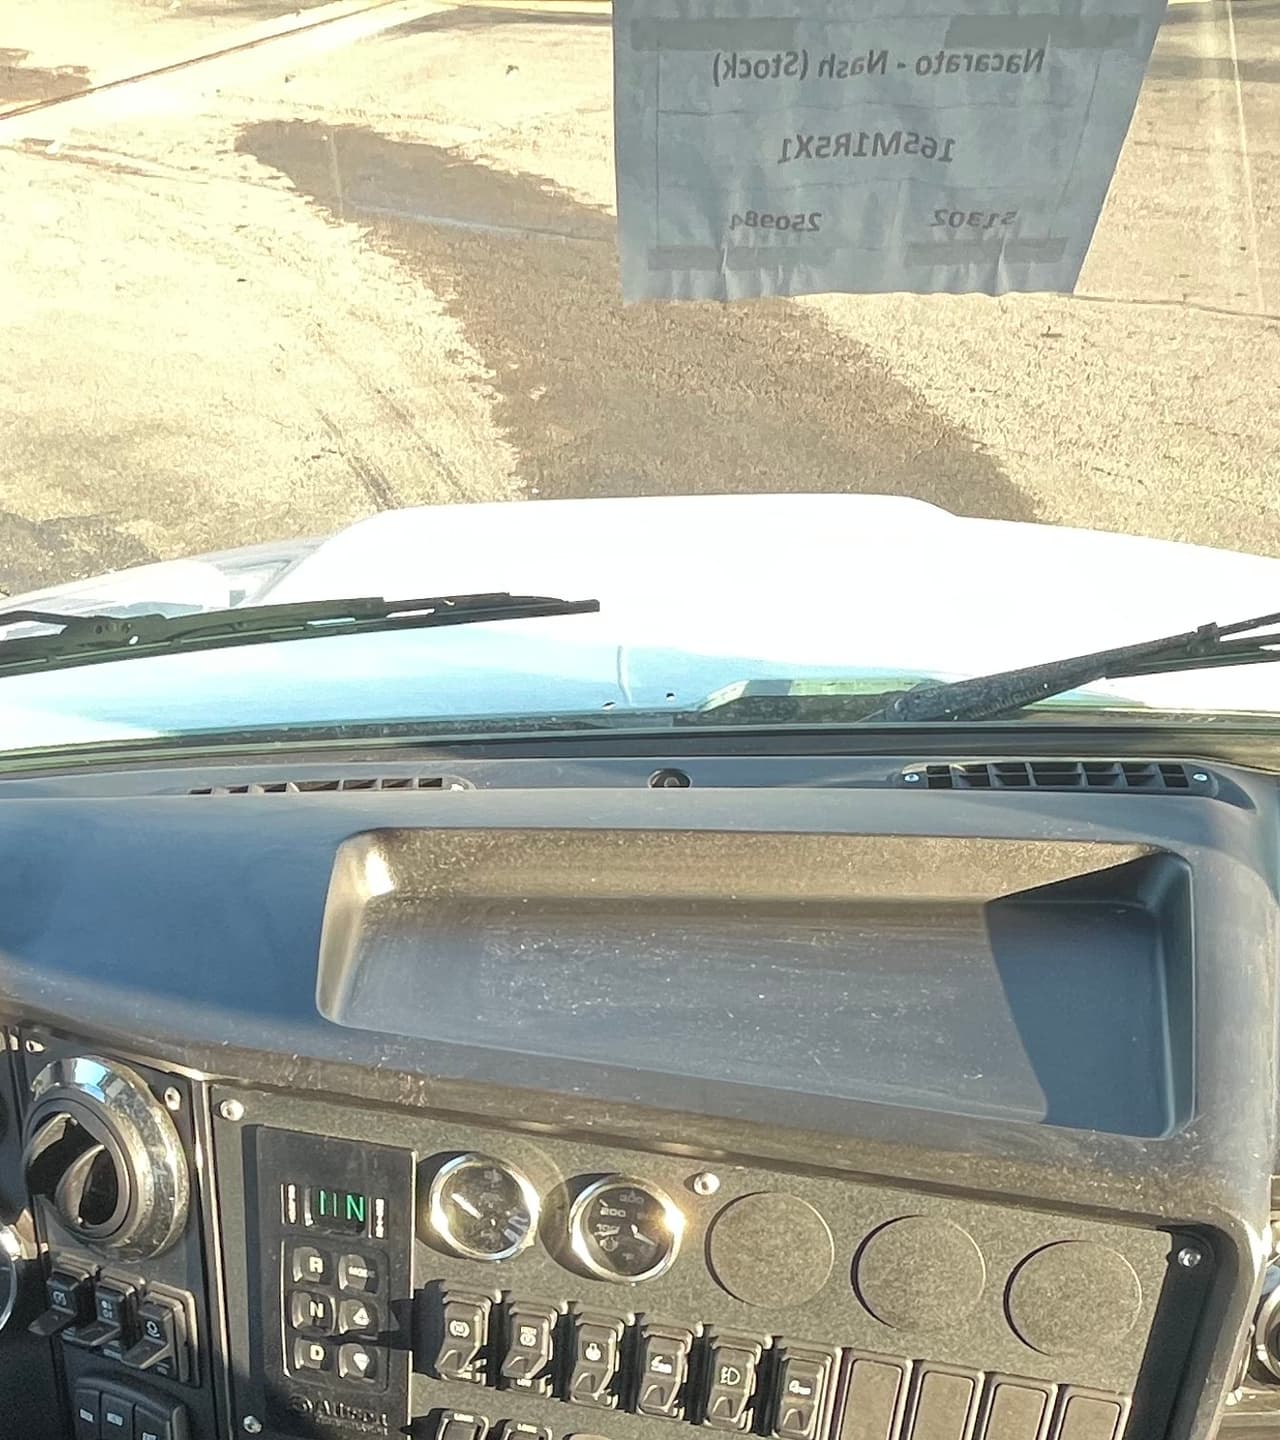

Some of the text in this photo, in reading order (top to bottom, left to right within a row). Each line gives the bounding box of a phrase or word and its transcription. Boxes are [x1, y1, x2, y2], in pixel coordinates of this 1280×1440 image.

[600, 1207, 627, 1218] 200
[309, 1256, 324, 1274] R
[309, 1300, 325, 1319] N
[309, 1343, 325, 1362] D
